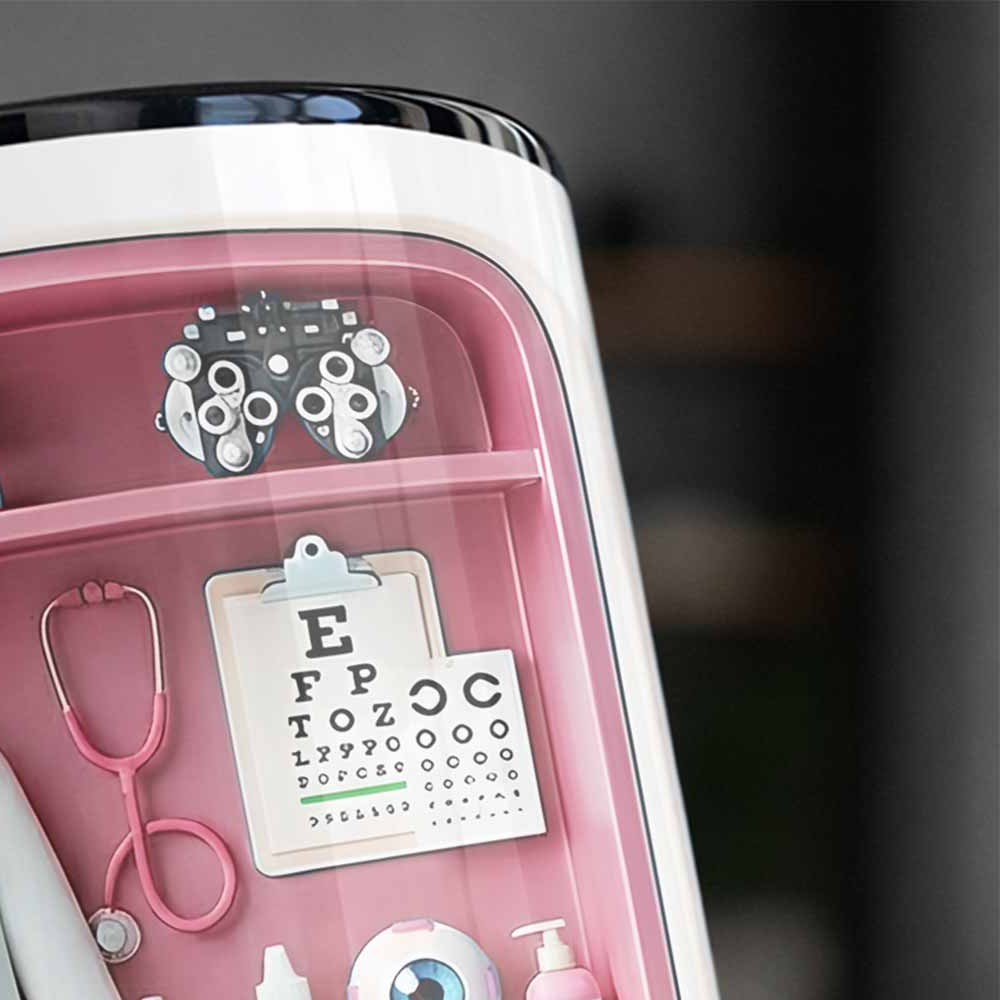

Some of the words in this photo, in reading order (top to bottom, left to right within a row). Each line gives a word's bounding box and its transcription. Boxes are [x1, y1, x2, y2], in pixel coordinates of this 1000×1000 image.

[298, 605, 353, 658] E
[291, 671, 320, 702] F
[347, 664, 376, 695] P
[288, 714, 310, 738] T
[330, 709, 354, 732] O
[373, 703, 395, 727] Z
